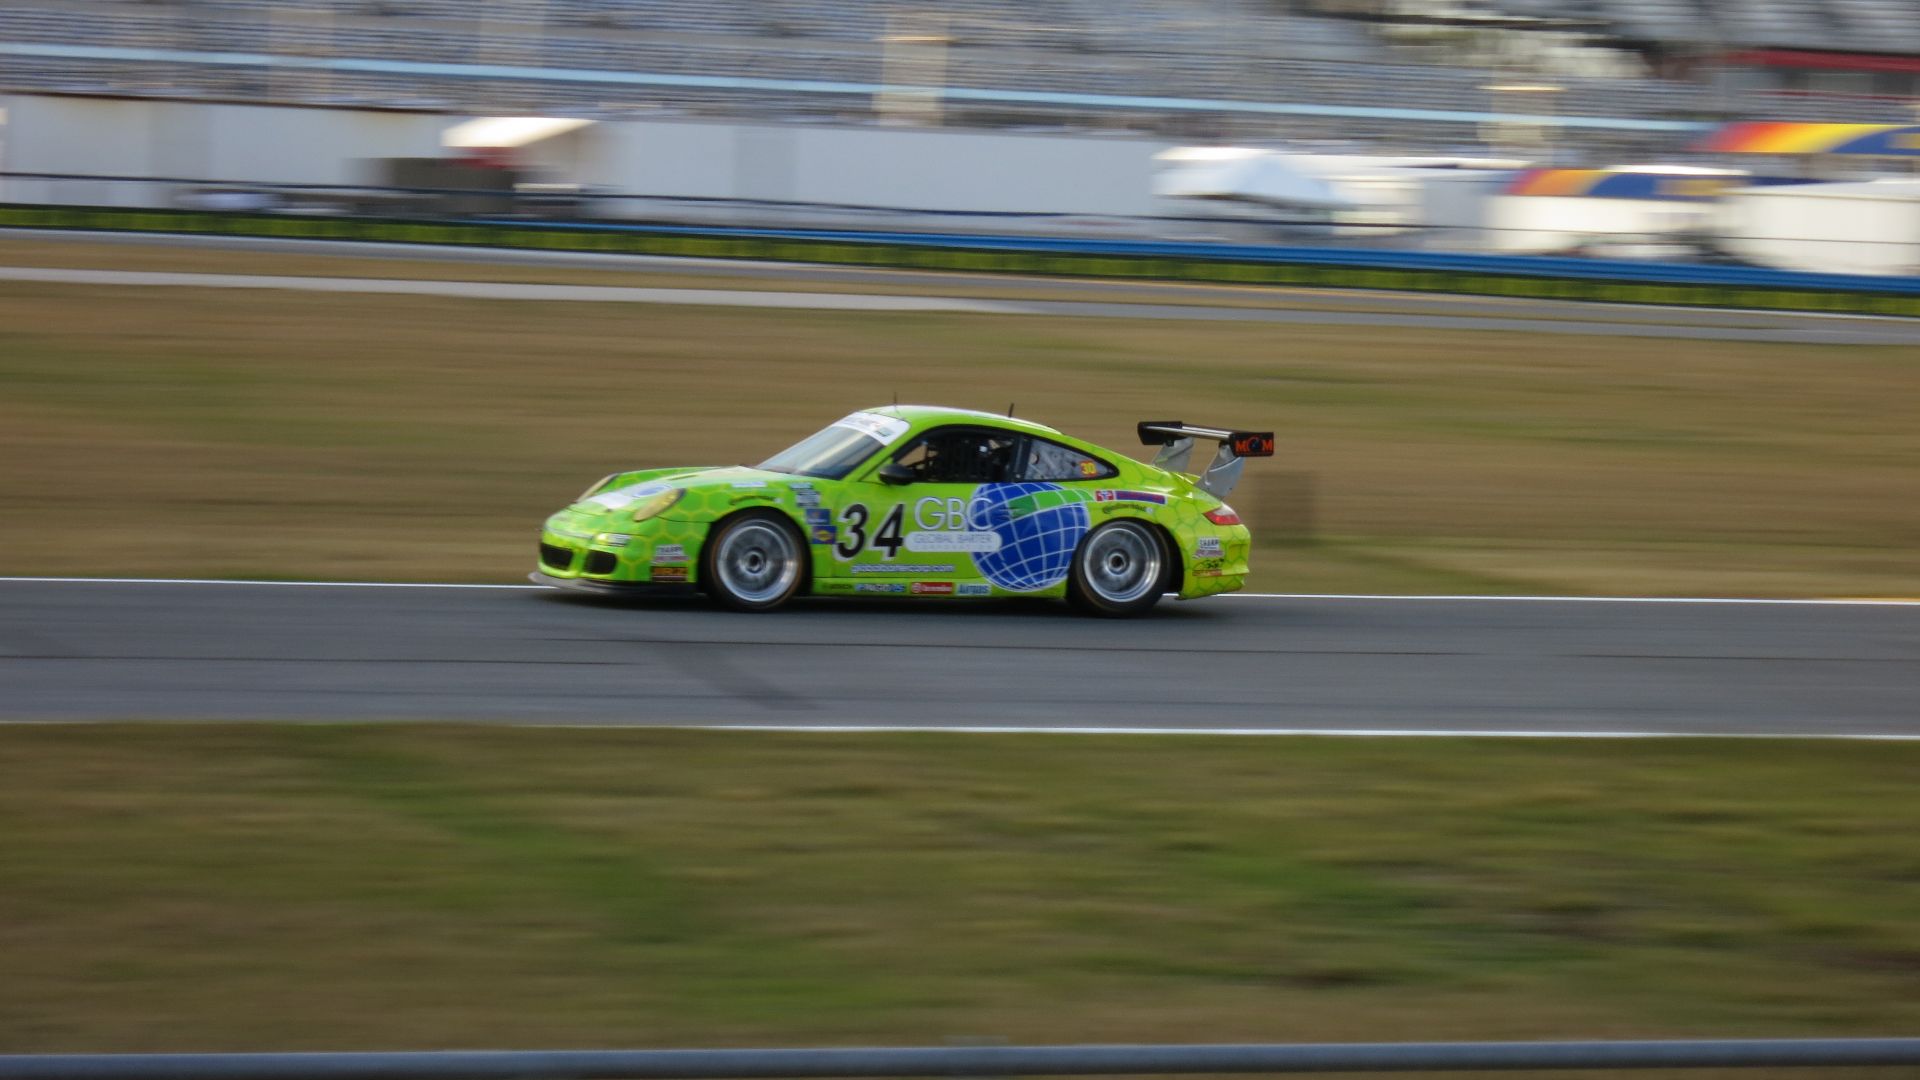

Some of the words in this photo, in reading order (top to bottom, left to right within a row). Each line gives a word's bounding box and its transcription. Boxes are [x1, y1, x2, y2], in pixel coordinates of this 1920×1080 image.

[1080, 461, 1096, 475] 30
[914, 496, 992, 532] GBC
[836, 502, 905, 558] 34
[914, 532, 956, 544] GLOBAL
[958, 532, 992, 544] BARTER
